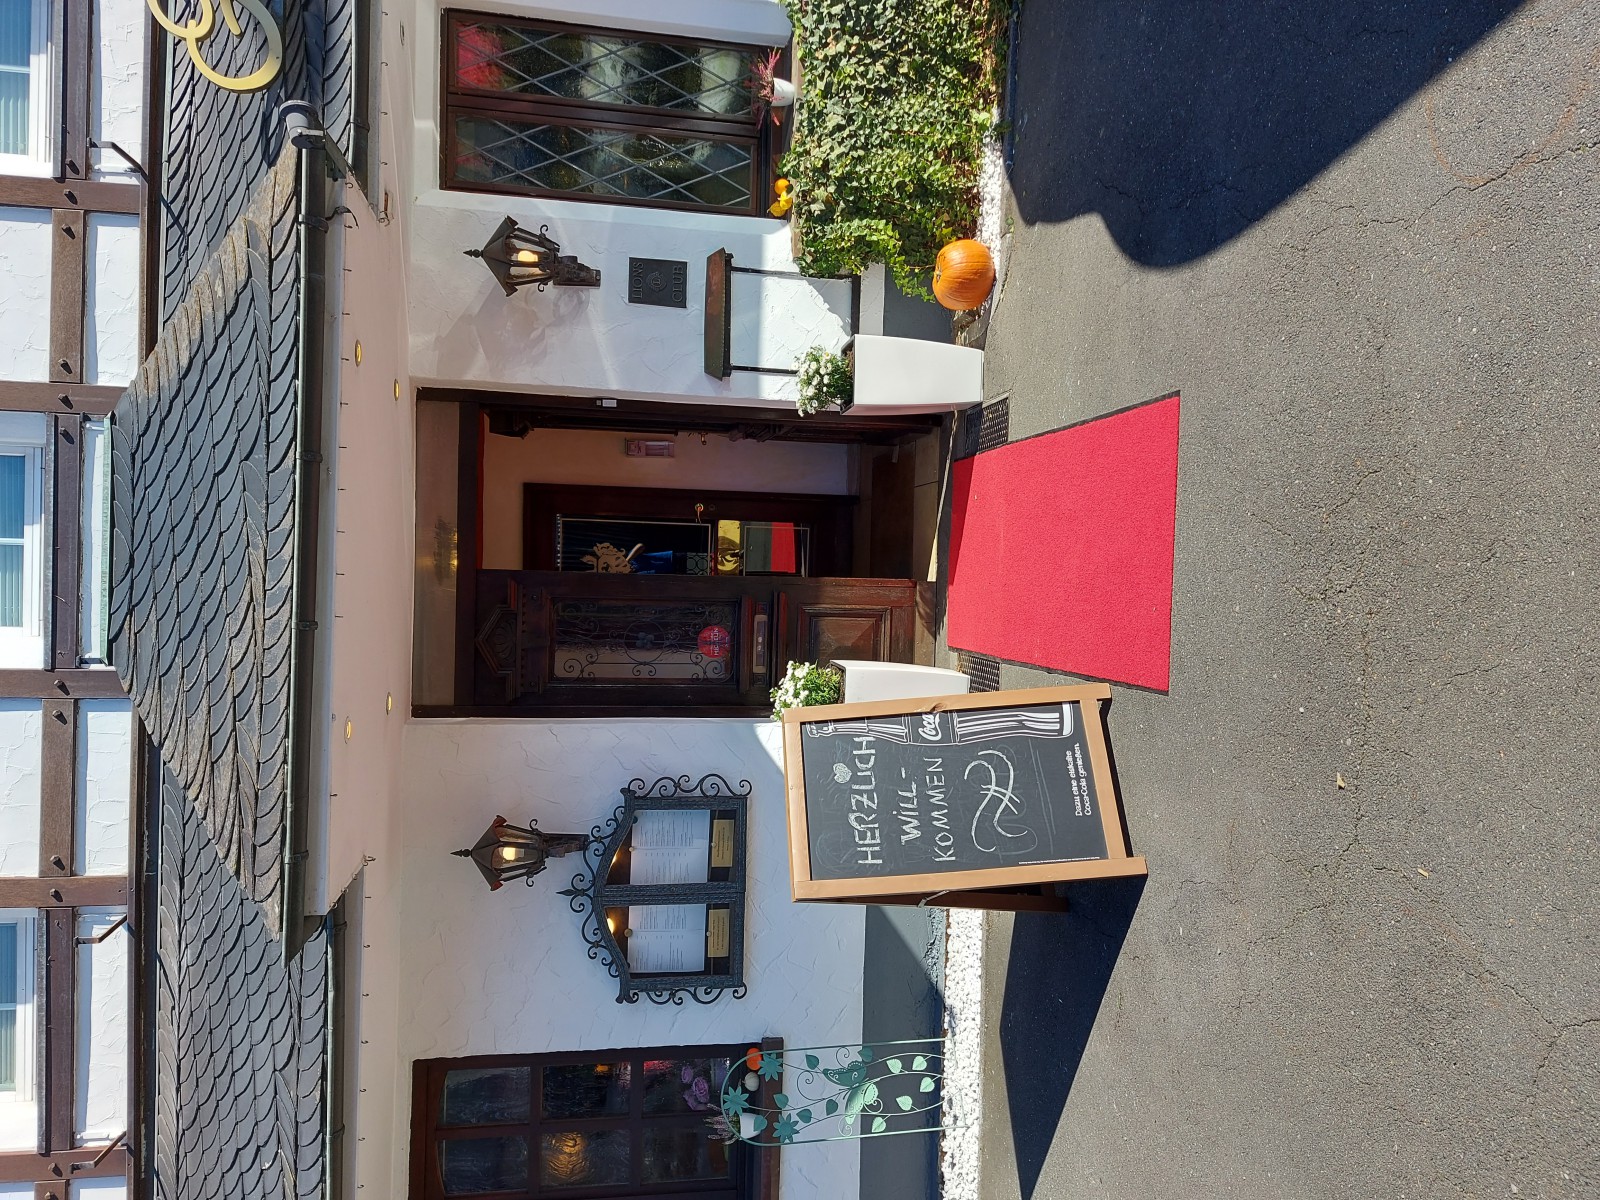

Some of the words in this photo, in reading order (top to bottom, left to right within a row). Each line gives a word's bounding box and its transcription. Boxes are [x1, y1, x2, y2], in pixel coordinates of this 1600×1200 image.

[633, 263, 643, 298] LIONS
[672, 265, 683, 302] CLUB
[1065, 750, 1076, 778] eiskalte
[1074, 742, 1087, 777] genießen.
[1070, 780, 1079, 795] eine
[1079, 778, 1092, 816] Coca-Cola
[923, 757, 956, 863] KOMMEN
[1073, 796, 1083, 817] Dazu
